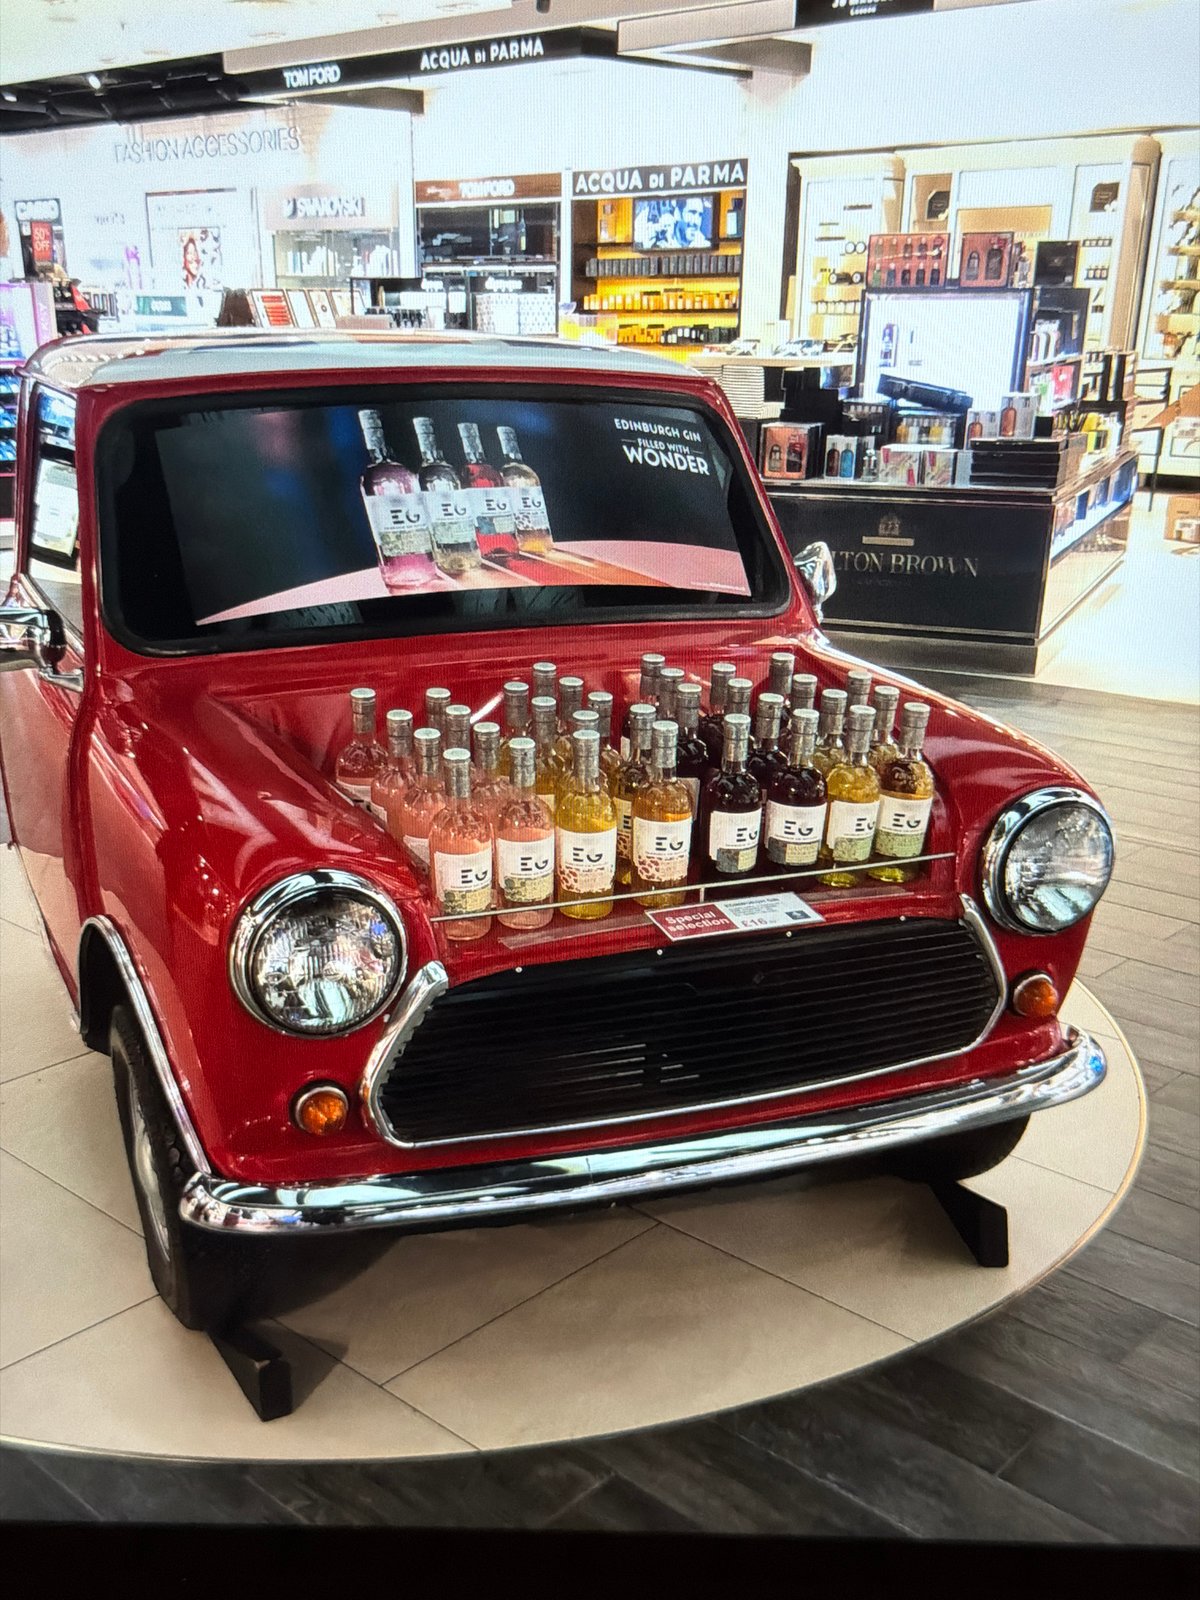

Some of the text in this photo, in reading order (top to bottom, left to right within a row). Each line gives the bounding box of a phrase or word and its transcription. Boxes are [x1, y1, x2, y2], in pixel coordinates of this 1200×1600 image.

[420, 46, 471, 71] ACQUA
[490, 36, 544, 62] PARMA
[283, 63, 341, 88] TOM FORD
[114, 126, 301, 164] FASHION ACCESSORIES
[575, 169, 643, 194] ACQUA
[670, 161, 744, 188] PARMA
[614, 418, 702, 442] EDINBURGH GIN
[637, 438, 690, 455] FILLED WITH
[622, 445, 710, 476] WONDER
[441, 503, 467, 517] EG
[485, 499, 507, 511] EG
[521, 496, 542, 509] EG
[390, 509, 420, 525] EG
[889, 553, 978, 578] BROWN
[784, 820, 814, 837] EG
[892, 813, 921, 829] EG
[736, 827, 758, 843] EG
[655, 836, 683, 851] EG
[573, 847, 603, 863] EG
[520, 856, 549, 872] EG
[461, 868, 488, 884] EG
[665, 910, 717, 926] Special
[667, 918, 730, 932] selection
